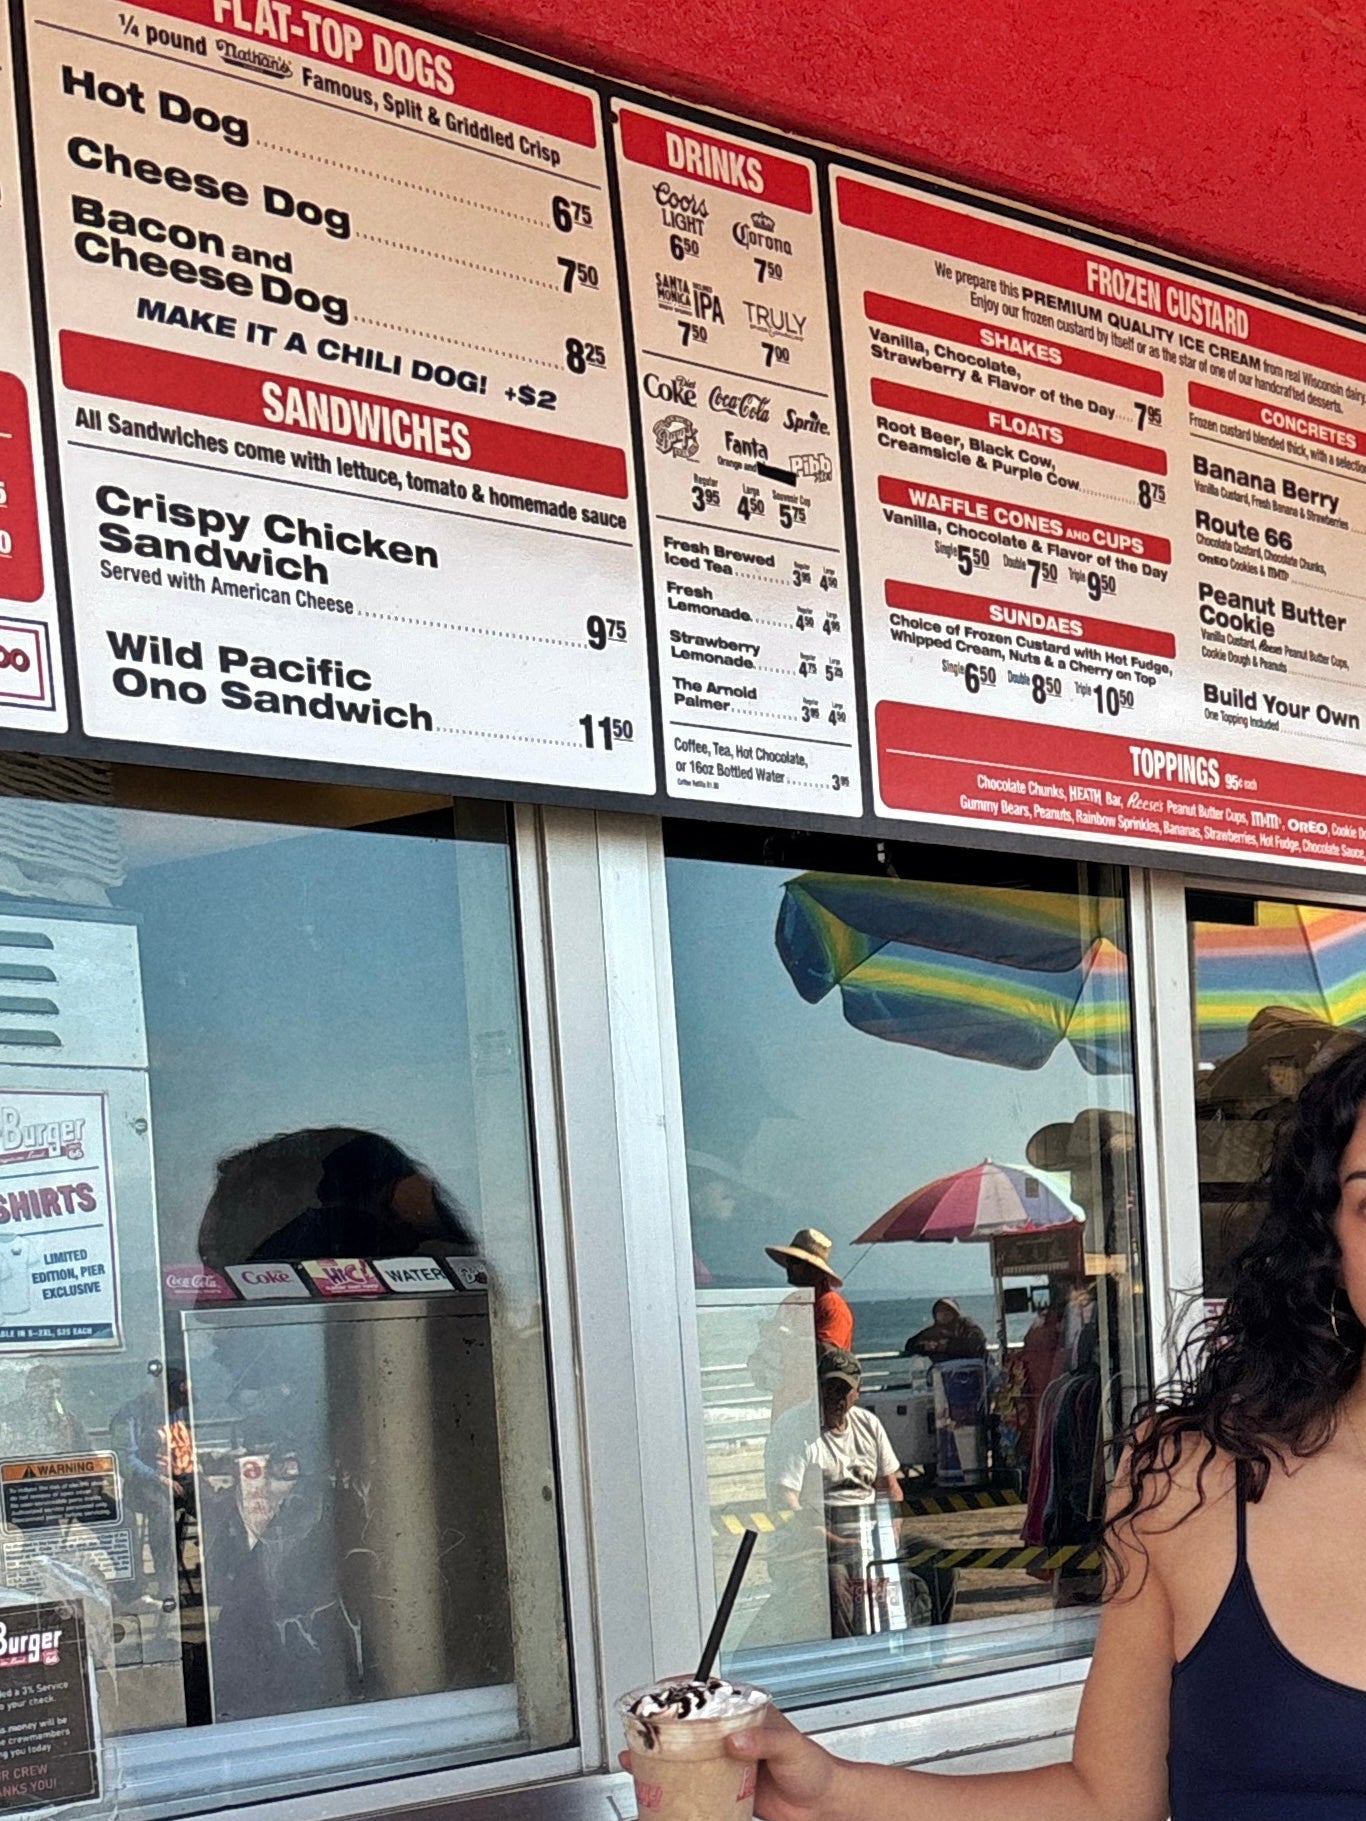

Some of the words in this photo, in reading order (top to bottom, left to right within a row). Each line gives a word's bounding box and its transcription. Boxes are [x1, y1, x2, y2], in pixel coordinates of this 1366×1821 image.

[213, 0, 362, 64] FLAT-TOP
[374, 34, 455, 94] DOGS
[61, 66, 145, 115] Hot
[159, 90, 249, 147] Dog
[146, 26, 206, 56] pound
[302, 67, 378, 113] Famous,
[383, 92, 423, 124] Split
[446, 111, 514, 150] Griddled
[519, 133, 561, 167] Crisp
[666, 132, 764, 194] DRINKS
[67, 136, 249, 206] Cheese
[264, 185, 350, 239] Dog
[652, 182, 709, 218] Coors
[552, 197, 592, 232] 675
[662, 209, 704, 236] LIGHT
[72, 195, 224, 257] Bacon
[232, 241, 293, 274] and
[732, 222, 792, 256] Corona
[74, 231, 253, 297] Cheese
[261, 272, 348, 325] Dog
[558, 259, 599, 294] 750
[655, 272, 690, 294] SANTA
[657, 286, 691, 308] MONICA
[694, 290, 724, 325] IPA
[1087, 260, 1160, 312] FROZEN
[1166, 286, 1249, 340] CUSTARD
[743, 301, 807, 336] TRULY
[956, 268, 997, 293] prepare
[1022, 287, 1101, 323] PREMIUM
[1108, 313, 1173, 343] QUALITY
[1178, 335, 1204, 354] ICE
[1209, 343, 1260, 370] CREAM
[1302, 372, 1344, 398] Wisconsin
[137, 298, 237, 339] MAKE
[246, 321, 276, 346] IT
[317, 338, 401, 375] CHILI
[411, 361, 487, 395] DOG!
[504, 384, 557, 410] +$2
[566, 338, 606, 375] 825
[869, 326, 930, 356] Vanilla,
[934, 344, 1021, 379] Chocolate,
[979, 329, 1062, 365] SHAKES
[871, 344, 966, 382] Strawberry
[987, 375, 1036, 398] Flavor
[643, 373, 697, 408] Coke
[709, 386, 771, 423] Coca-Cola
[262, 381, 471, 461] SANDWICHES
[989, 412, 1063, 445] FLOATS
[1261, 408, 1358, 449] CONCRETES
[724, 431, 768, 460] Fanta
[877, 416, 916, 437] Root
[921, 427, 965, 450] Beer,
[969, 437, 1013, 459] Black
[1018, 450, 1056, 471] Cow,
[878, 433, 971, 465] Creamsicle
[992, 461, 1042, 484] Purple
[75, 406, 102, 430] All
[108, 413, 228, 457] Sandwiches
[234, 443, 285, 466] come
[290, 446, 331, 476] with
[337, 456, 402, 491] lettuce,
[406, 470, 466, 500] tomato
[489, 487, 576, 521] homemade
[581, 507, 627, 529] sauce
[789, 453, 832, 478] Pibb
[1193, 455, 1276, 495] Banana
[1283, 478, 1339, 514] Berry
[96, 486, 250, 546] Crispy
[264, 514, 438, 569] Chicken
[908, 488, 988, 521] WAFFLE
[994, 507, 1063, 536] CONES
[1093, 529, 1144, 554] CUPS
[1195, 509, 1260, 543] Route
[1265, 527, 1292, 550] 66
[100, 524, 329, 586] Sandwich
[663, 536, 709, 558] Fresh
[713, 545, 774, 568] Brewed
[882, 508, 942, 533] Vanilla,
[1142, 564, 1168, 582] Day
[664, 552, 699, 571] Iced
[703, 559, 733, 576] Tea
[101, 560, 163, 587] Served
[211, 575, 291, 607] American
[295, 589, 354, 616] Cheese
[667, 581, 712, 601] Fresh
[668, 598, 750, 622] Lemonade
[989, 604, 1082, 637] SUNDAES
[1199, 582, 1275, 618] Peanut
[1282, 600, 1346, 632] Butter
[1200, 605, 1275, 638] Cookie
[586, 615, 627, 650] 975
[669, 630, 760, 657] Strawberry
[890, 613, 941, 634] Choice
[964, 627, 1012, 646] Frozen
[1016, 635, 1071, 656] Custard
[1132, 655, 1172, 677] Fudge,
[107, 630, 202, 671] Wild
[219, 645, 372, 693] Pacific
[671, 646, 753, 670] Lemonade
[891, 629, 952, 651] Whipped
[956, 639, 1005, 661] Cream,
[1070, 659, 1113, 681] Cherry
[1135, 670, 1156, 687] Top
[112, 669, 207, 706] Ono
[221, 681, 434, 733] Sandwich
[672, 677, 702, 693] The
[706, 681, 757, 700] Arnold
[674, 694, 730, 712] Palmer
[1204, 683, 1257, 711] Build
[1263, 694, 1310, 721] Your
[1316, 705, 1360, 730] Own
[674, 738, 711, 757] Coffee,
[735, 745, 752, 761] Hot
[755, 748, 808, 768] Chocolate,
[1129, 746, 1220, 788] TOPPINGS
[689, 759, 714, 776] 16oz
[717, 763, 753, 781] Bottled
[756, 768, 785, 784] Water
[978, 774, 1026, 794] Chocolate
[1028, 781, 1067, 801] Chunks,
[1069, 786, 1101, 805] HEATH
[1166, 799, 1196, 817] Peanut
[1287, 818, 1327, 835] OREO
[1076, 811, 1116, 828] Rainbow
[1164, 820, 1202, 840] Bananas,
[2, 1106, 85, 1158] Burger
[32, 1269, 78, 1284] EDITION,
[81, 1264, 105, 1277] PIER
[44, 1249, 87, 1265] LIMITED
[43, 1282, 101, 1300] EXCLUSIVE
[241, 1271, 290, 1286] Coke
[385, 1268, 444, 1283] WATER
[38, 1462, 94, 1476] WARNING
[36, 1681, 68, 1693] Service
[7, 1701, 25, 1712] your
[8, 1721, 37, 1734] money
[28, 1744, 51, 1756] today
[13, 1764, 48, 1778] CREW
[30, 1778, 56, 1790] YOU!
